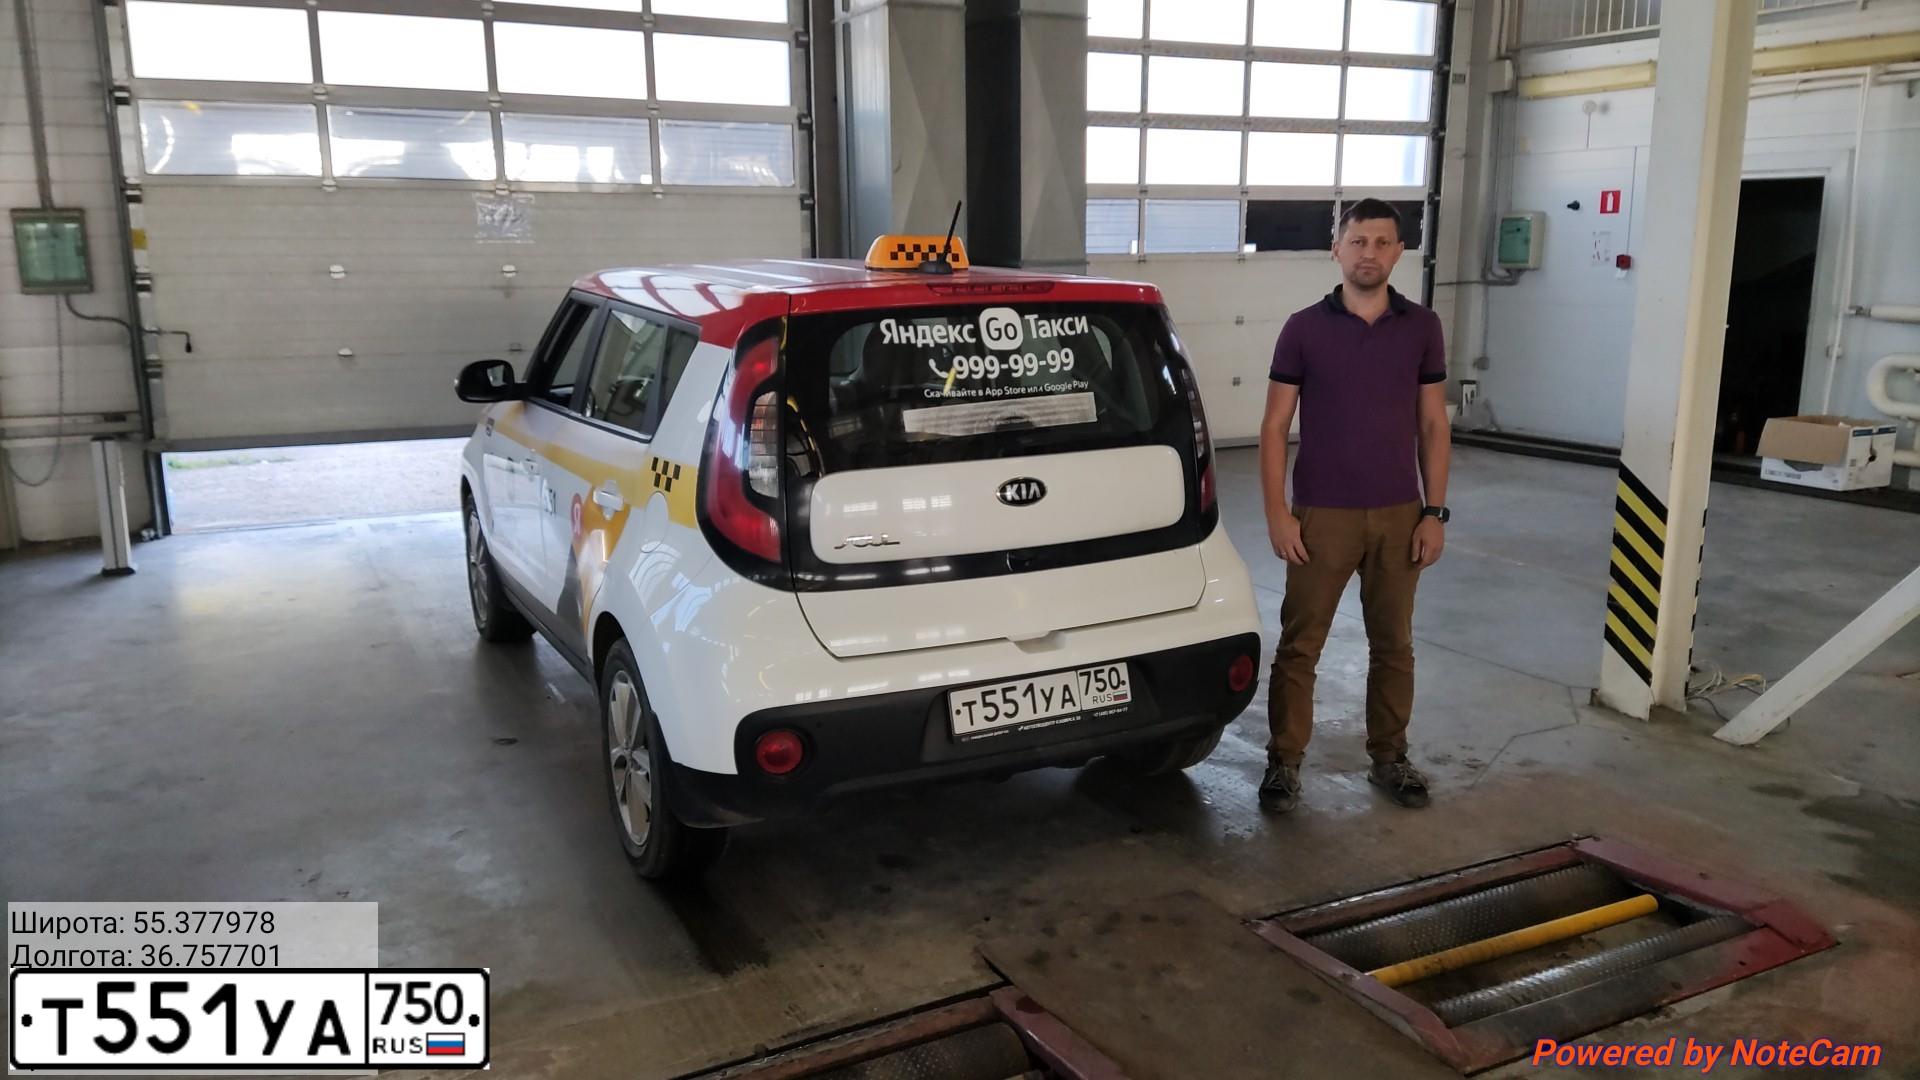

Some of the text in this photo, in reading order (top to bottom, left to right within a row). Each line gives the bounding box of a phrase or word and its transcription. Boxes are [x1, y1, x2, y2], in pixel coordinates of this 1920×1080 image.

[880, 314, 1089, 348] Яндекс Go Такси
[952, 347, 1075, 380] 999-99-99
[985, 386, 1003, 397] App
[1004, 383, 1027, 395] Store
[1044, 381, 1072, 393] Google
[1073, 379, 1089, 390] Play
[1005, 482, 1041, 501] KIA
[1078, 666, 1121, 697] 750
[1092, 693, 1113, 705] RUS
